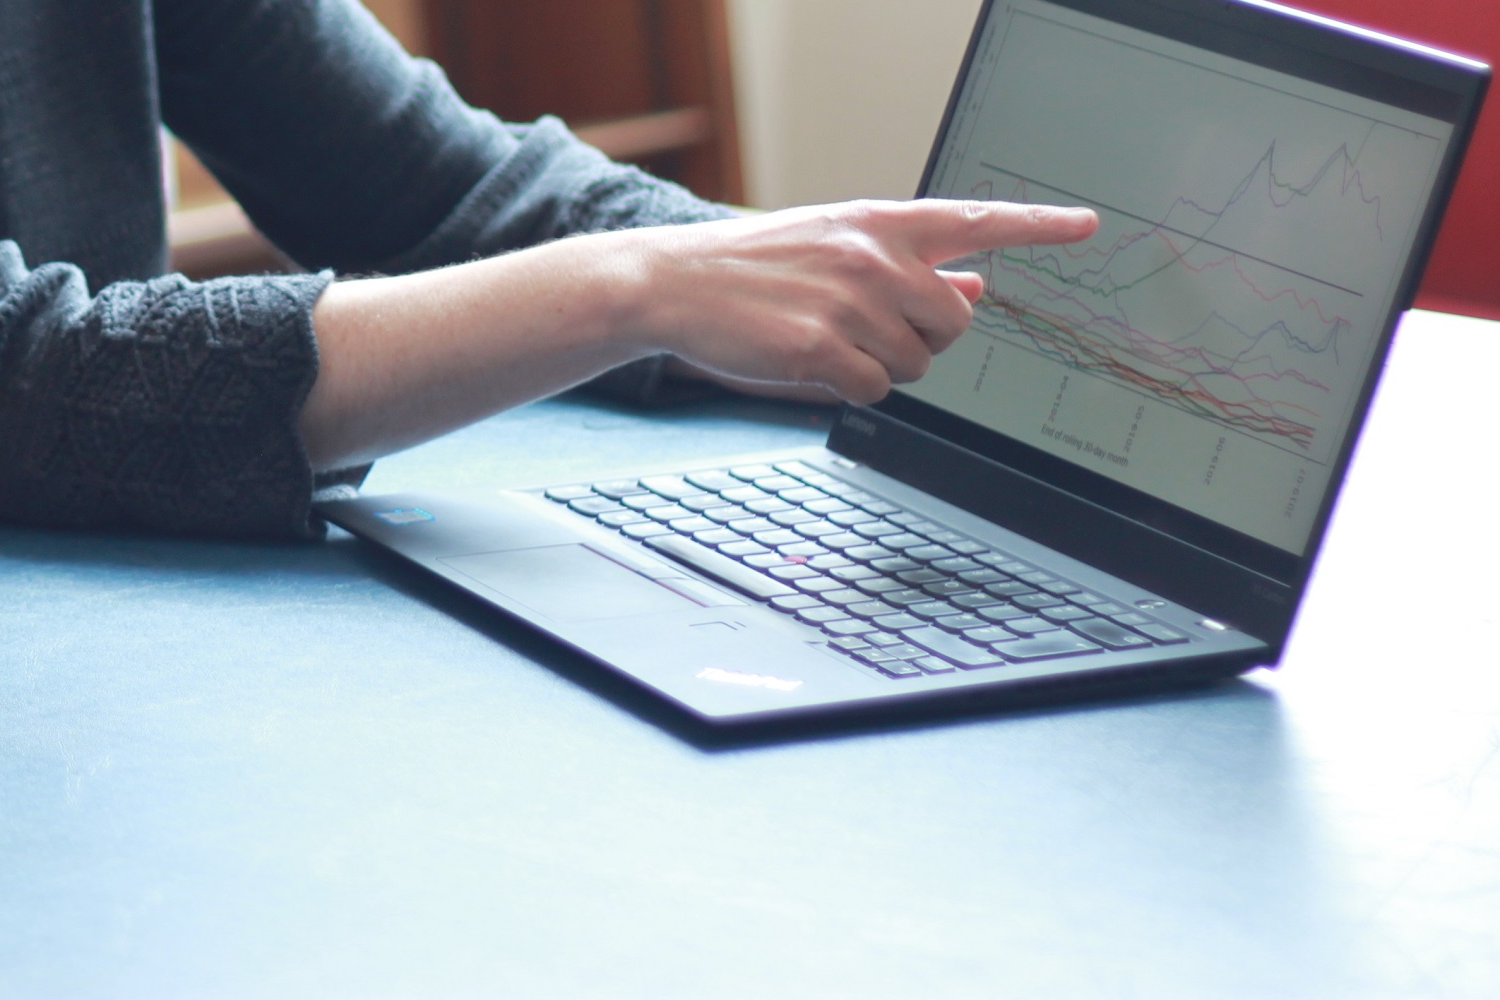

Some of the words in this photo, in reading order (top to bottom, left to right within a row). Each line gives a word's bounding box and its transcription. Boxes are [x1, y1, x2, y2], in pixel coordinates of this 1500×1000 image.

[1041, 423, 1055, 437] End
[1054, 430, 1064, 441] of
[1063, 434, 1084, 450] rolling
[1084, 441, 1106, 460] 30-day
[1107, 451, 1129, 467] month
[1124, 405, 1145, 453] 2019-05
[1204, 436, 1226, 486] 2019-06
[1285, 468, 1307, 519] 2019-07
